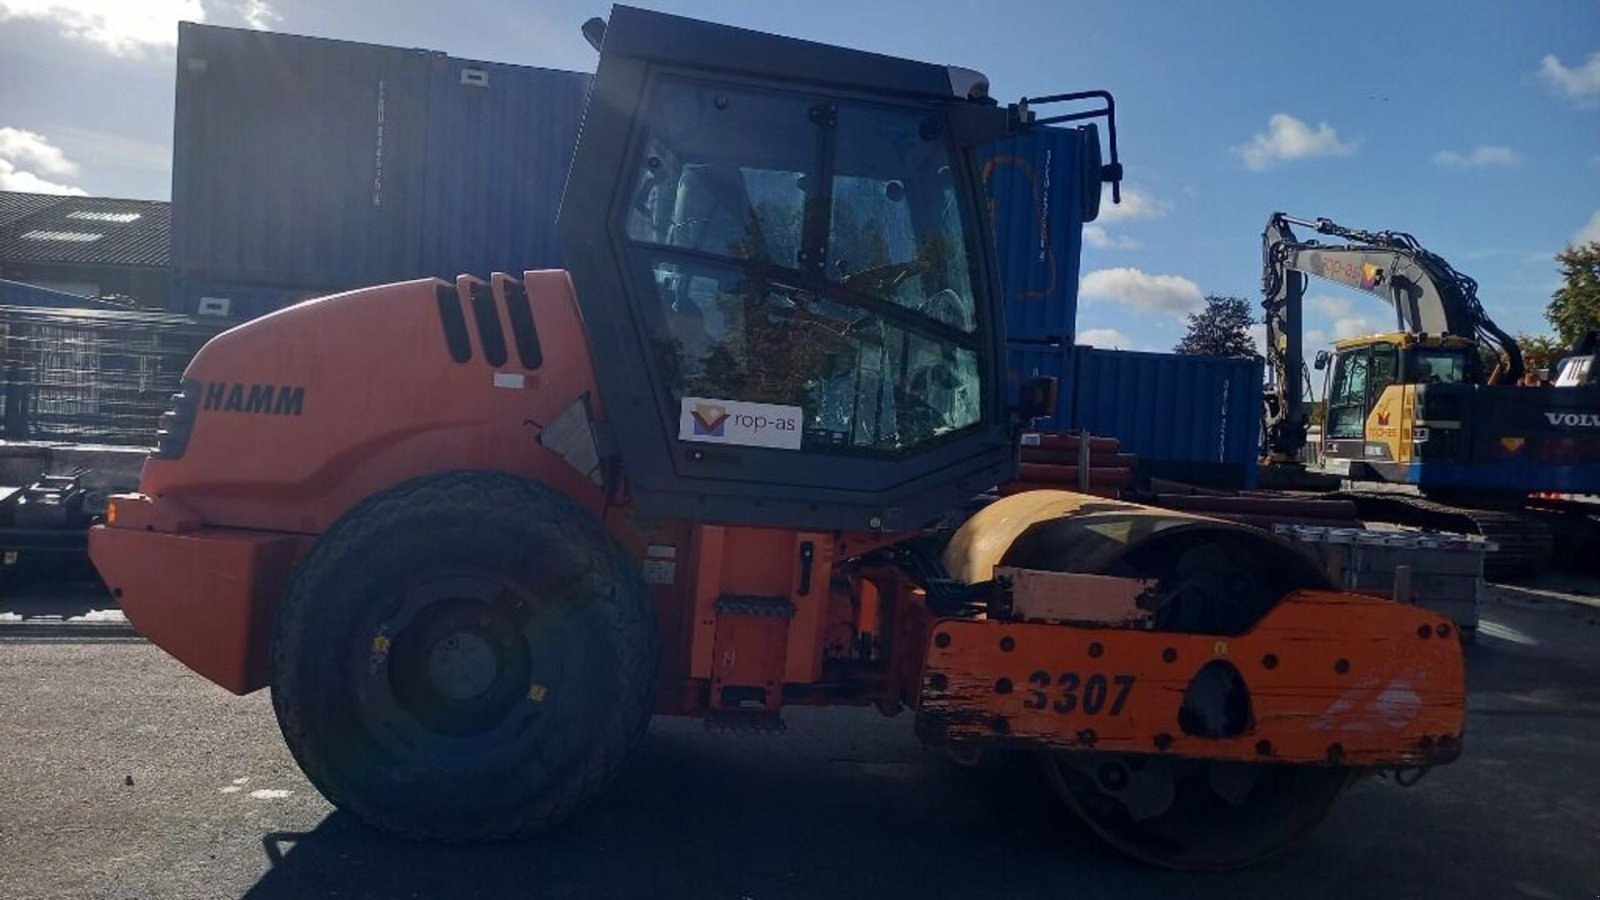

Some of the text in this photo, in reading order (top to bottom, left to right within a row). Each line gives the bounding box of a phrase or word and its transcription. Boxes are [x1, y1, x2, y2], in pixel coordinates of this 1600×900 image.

[203, 382, 305, 415] HAMM
[734, 413, 795, 432] rop-as
[1023, 669, 1137, 716] 3307
